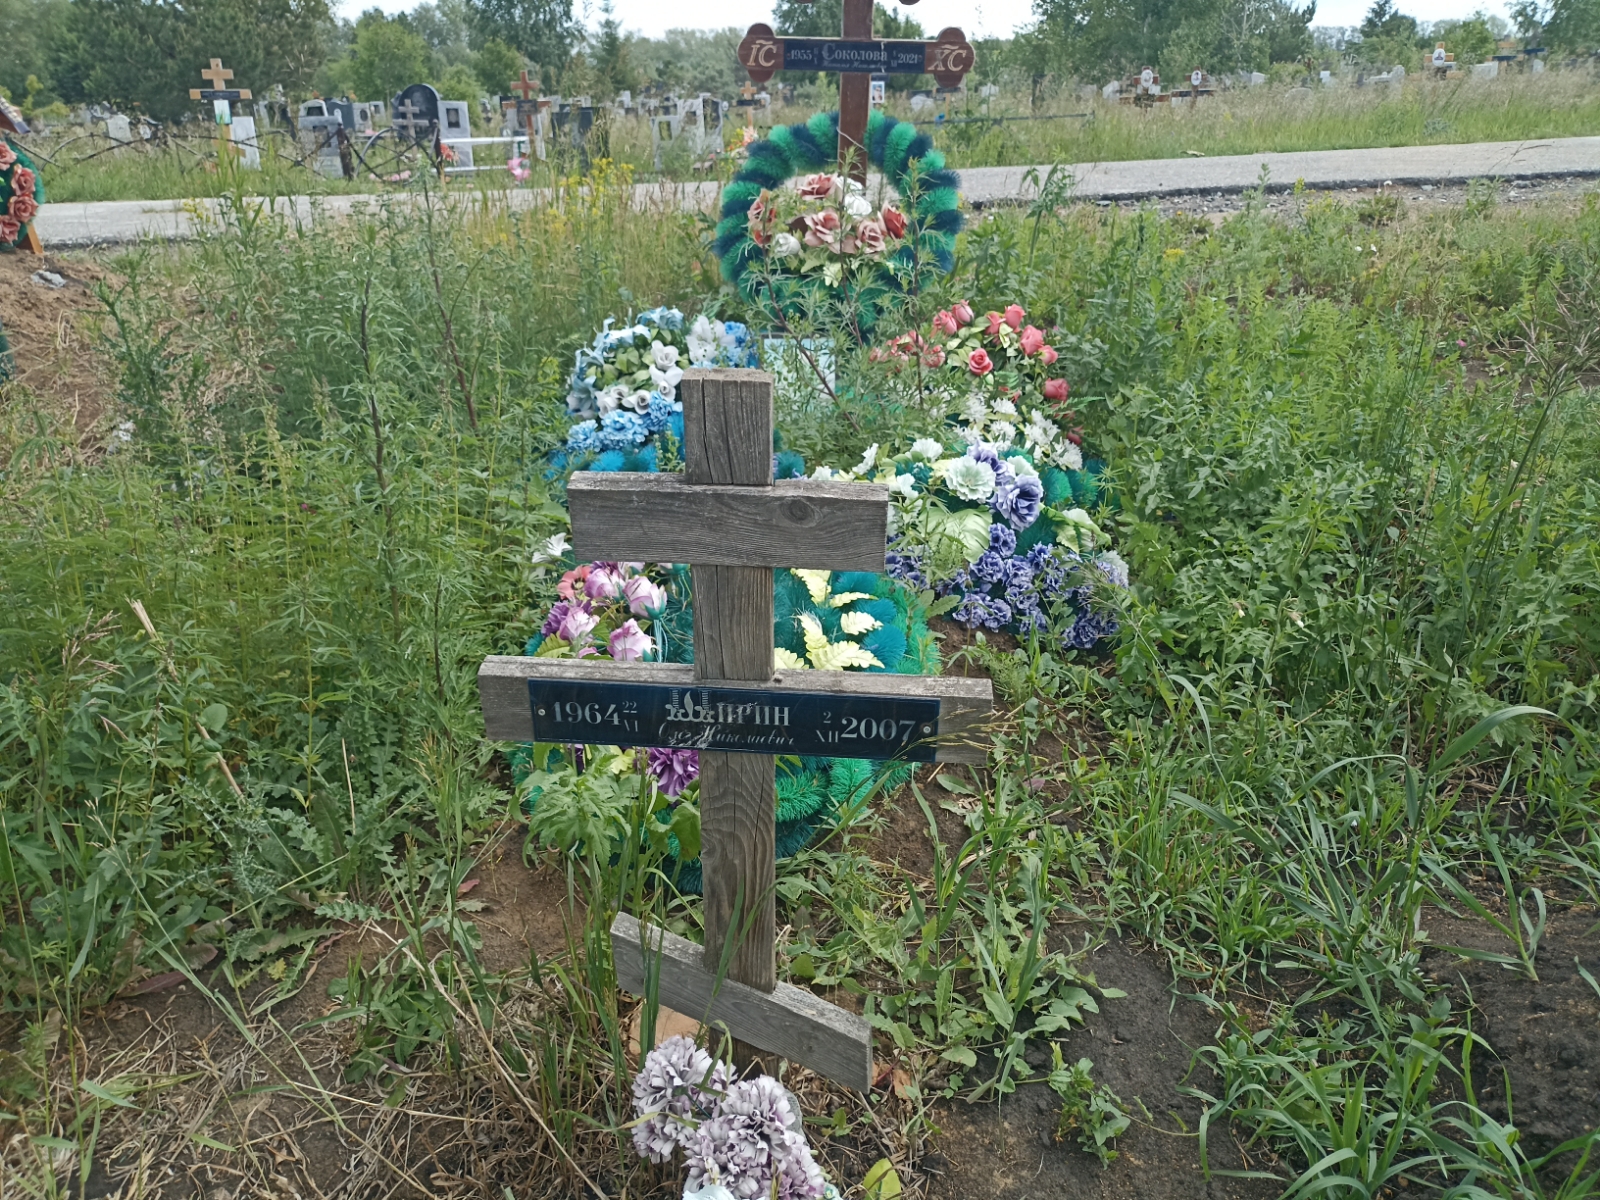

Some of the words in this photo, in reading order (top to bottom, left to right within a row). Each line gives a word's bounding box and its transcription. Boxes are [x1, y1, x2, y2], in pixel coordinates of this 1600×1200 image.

[790, 49, 813, 60] 1955
[822, 42, 888, 61] Соколова
[897, 53, 918, 64] 2021
[552, 701, 621, 725] 1964
[622, 700, 638, 713] 22
[822, 711, 832, 723] 2
[840, 716, 916, 741] 2007
